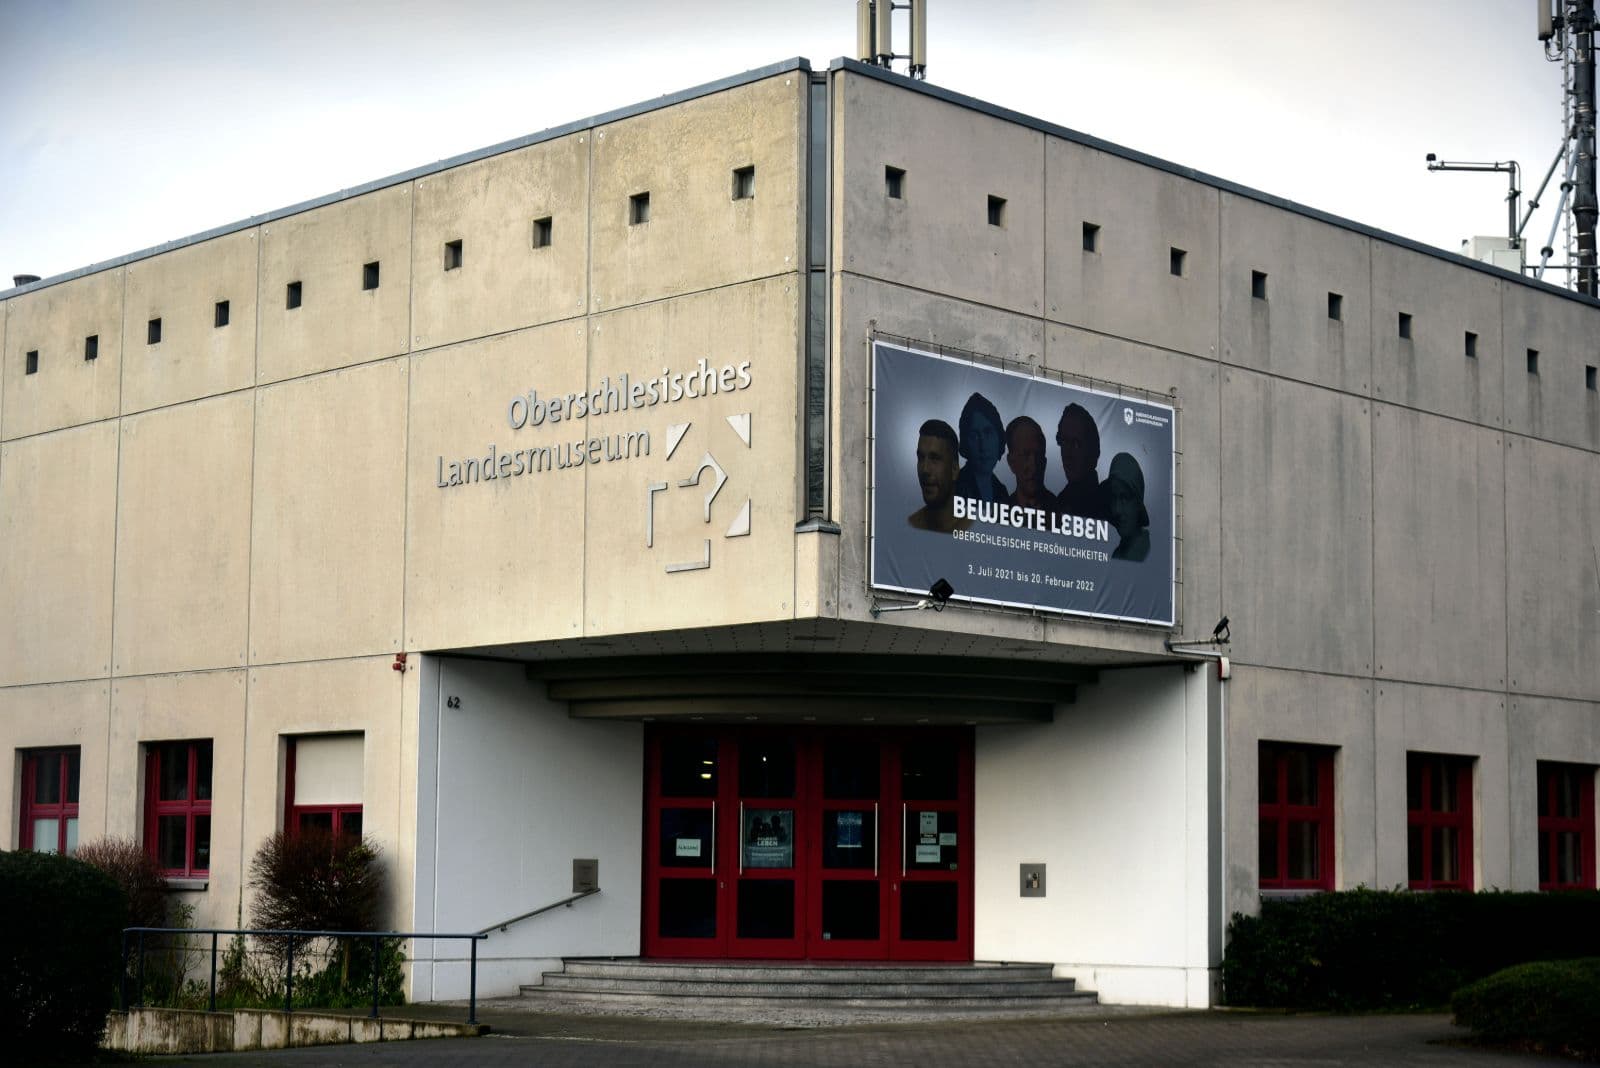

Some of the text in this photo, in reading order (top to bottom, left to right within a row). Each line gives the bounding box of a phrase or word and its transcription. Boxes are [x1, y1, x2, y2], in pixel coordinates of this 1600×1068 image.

[507, 358, 752, 430] Oberschlesisches
[436, 429, 651, 488] Landesmuseum
[953, 495, 1109, 542] BEWEGTE LEBEN
[952, 529, 1109, 563] OBERSCHLESISCHE PERSÖNLICHKEITEN
[968, 564, 1095, 592] 3. Juli 2021 bis 20. Februar 2022
[447, 695, 461, 710] 62
